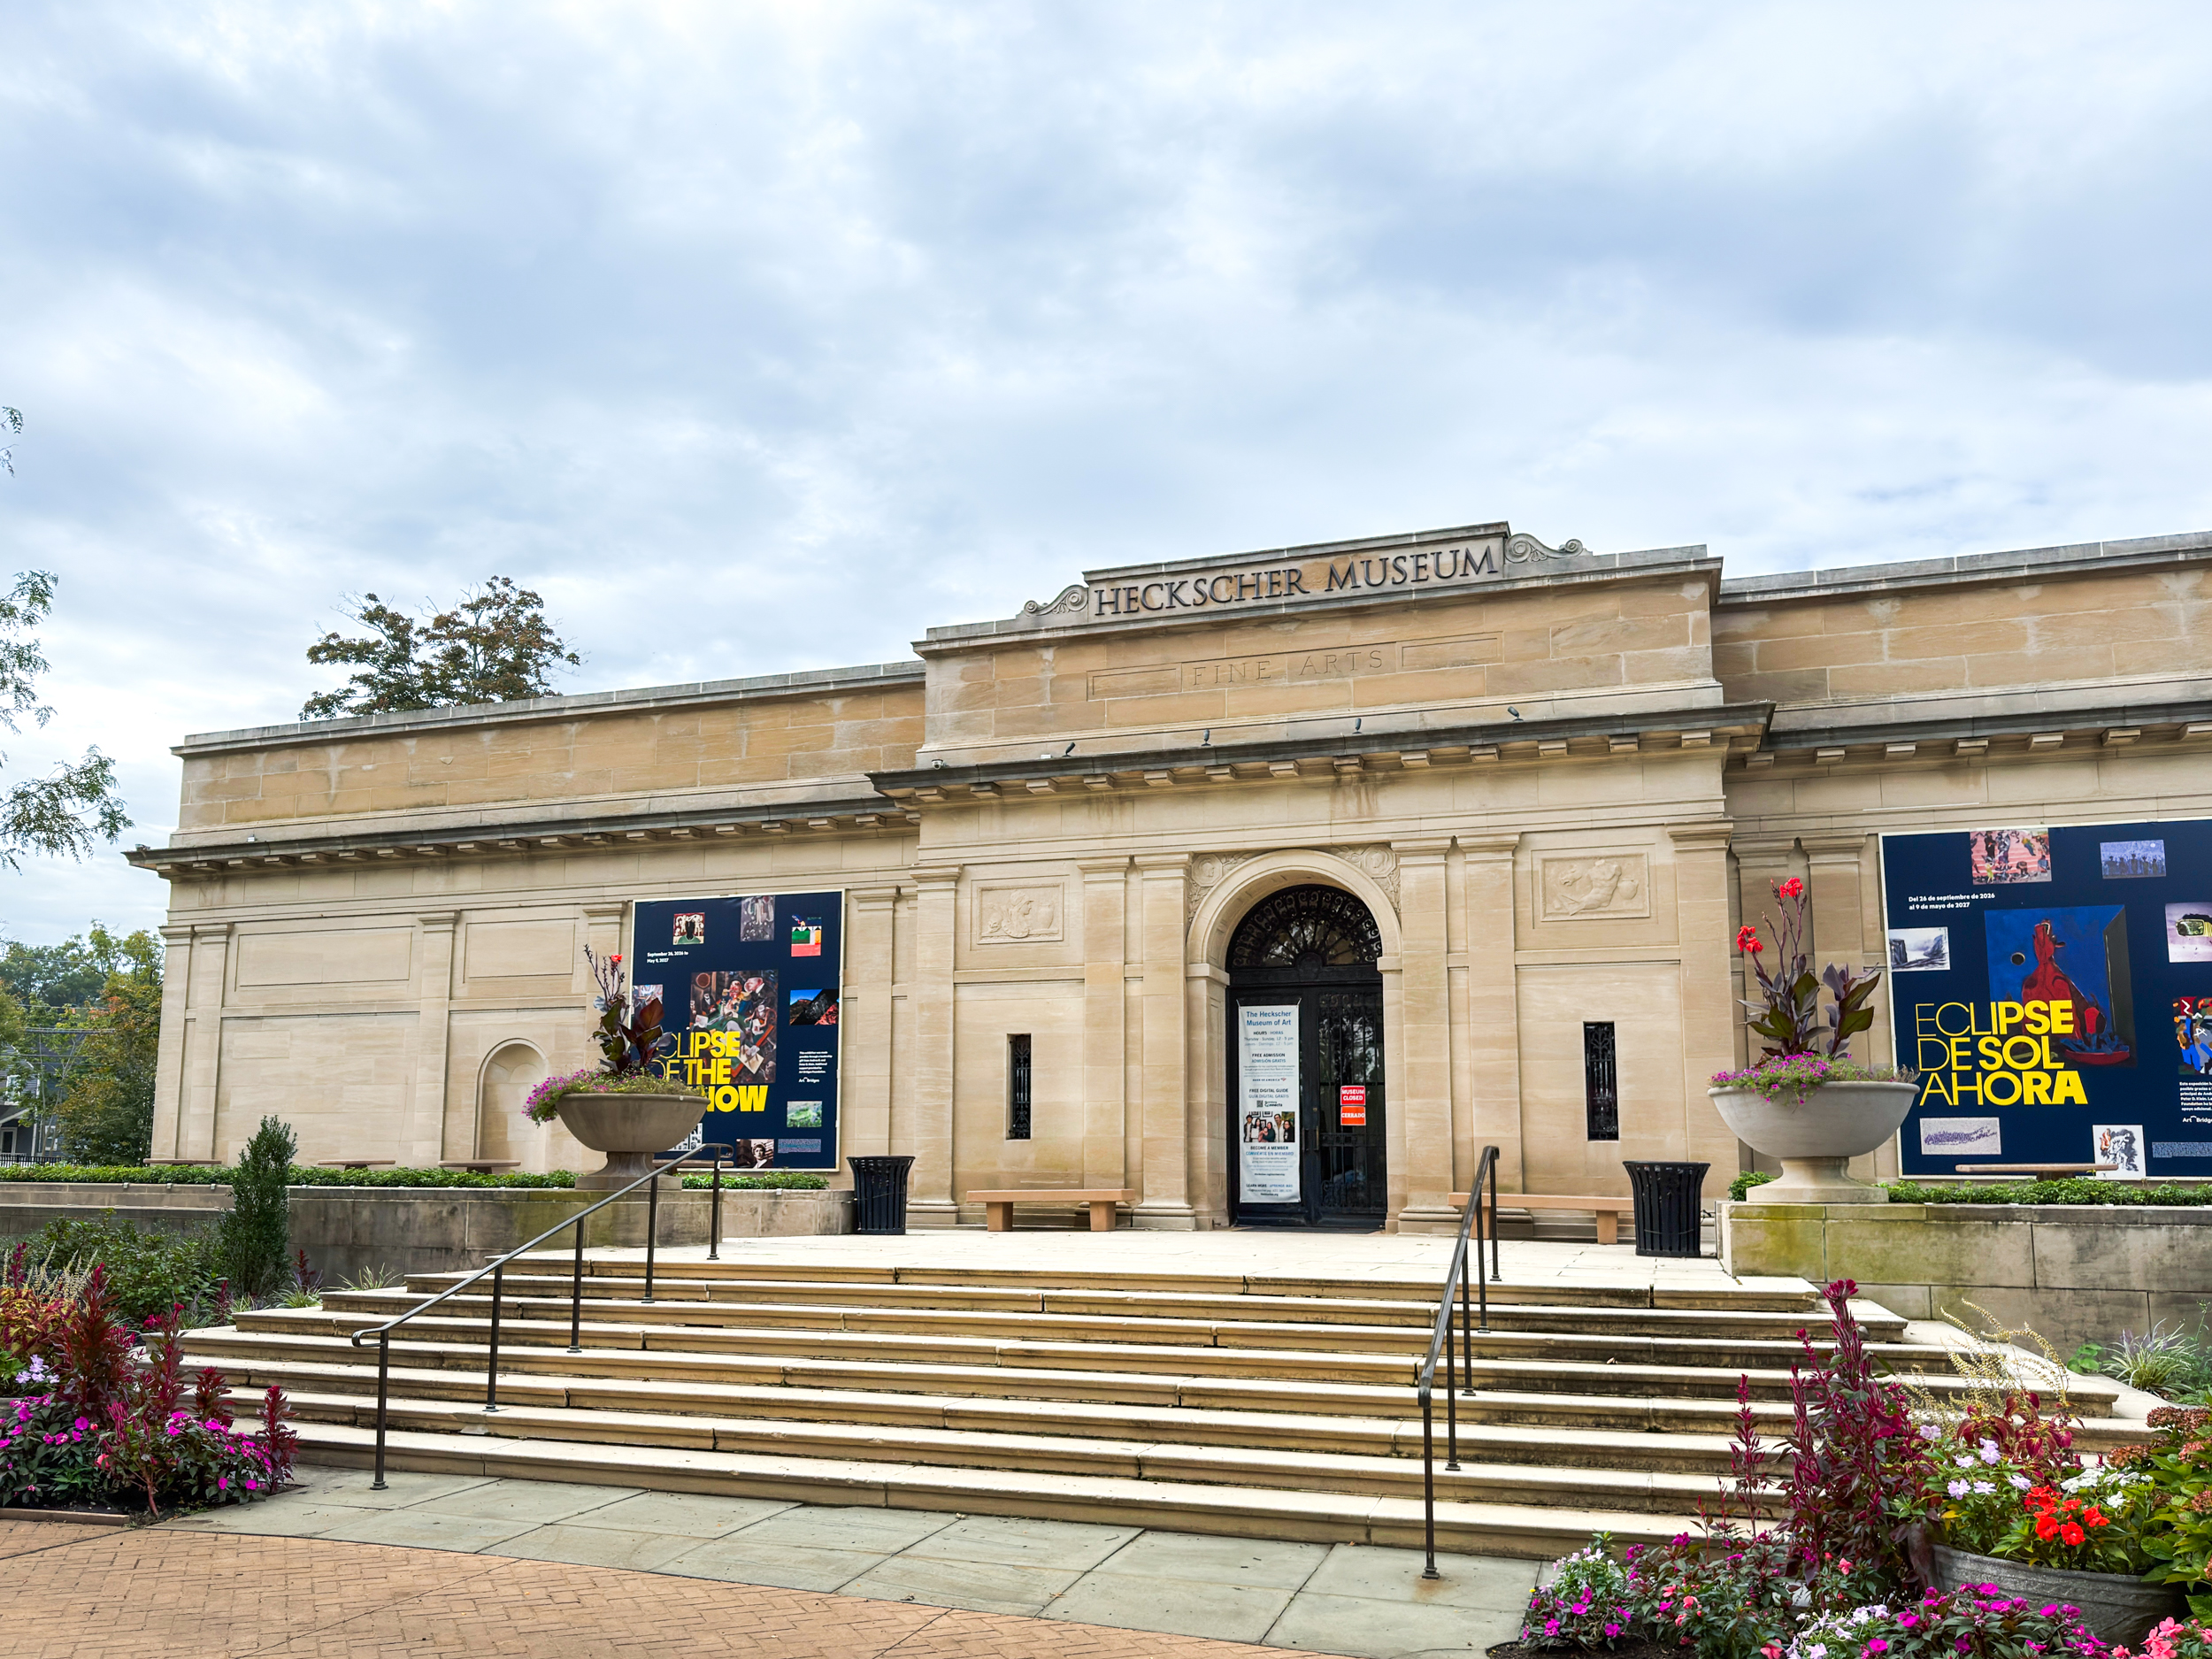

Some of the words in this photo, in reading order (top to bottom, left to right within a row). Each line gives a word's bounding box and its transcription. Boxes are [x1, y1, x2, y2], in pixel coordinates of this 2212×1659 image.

[1094, 567, 1310, 616] HECKSCHER
[1324, 545, 1500, 592] MUSEUM
[1193, 660, 1271, 686] FINE
[1299, 649, 1384, 676] ARTS
[1916, 999, 2074, 1037] ECLIPSE
[657, 1031, 741, 1059] CLIPSE
[1917, 1037, 1972, 1072] DE
[1978, 1035, 2064, 1071] SOL
[684, 1058, 731, 1085] THE
[1919, 1071, 2088, 1106] AHORA
